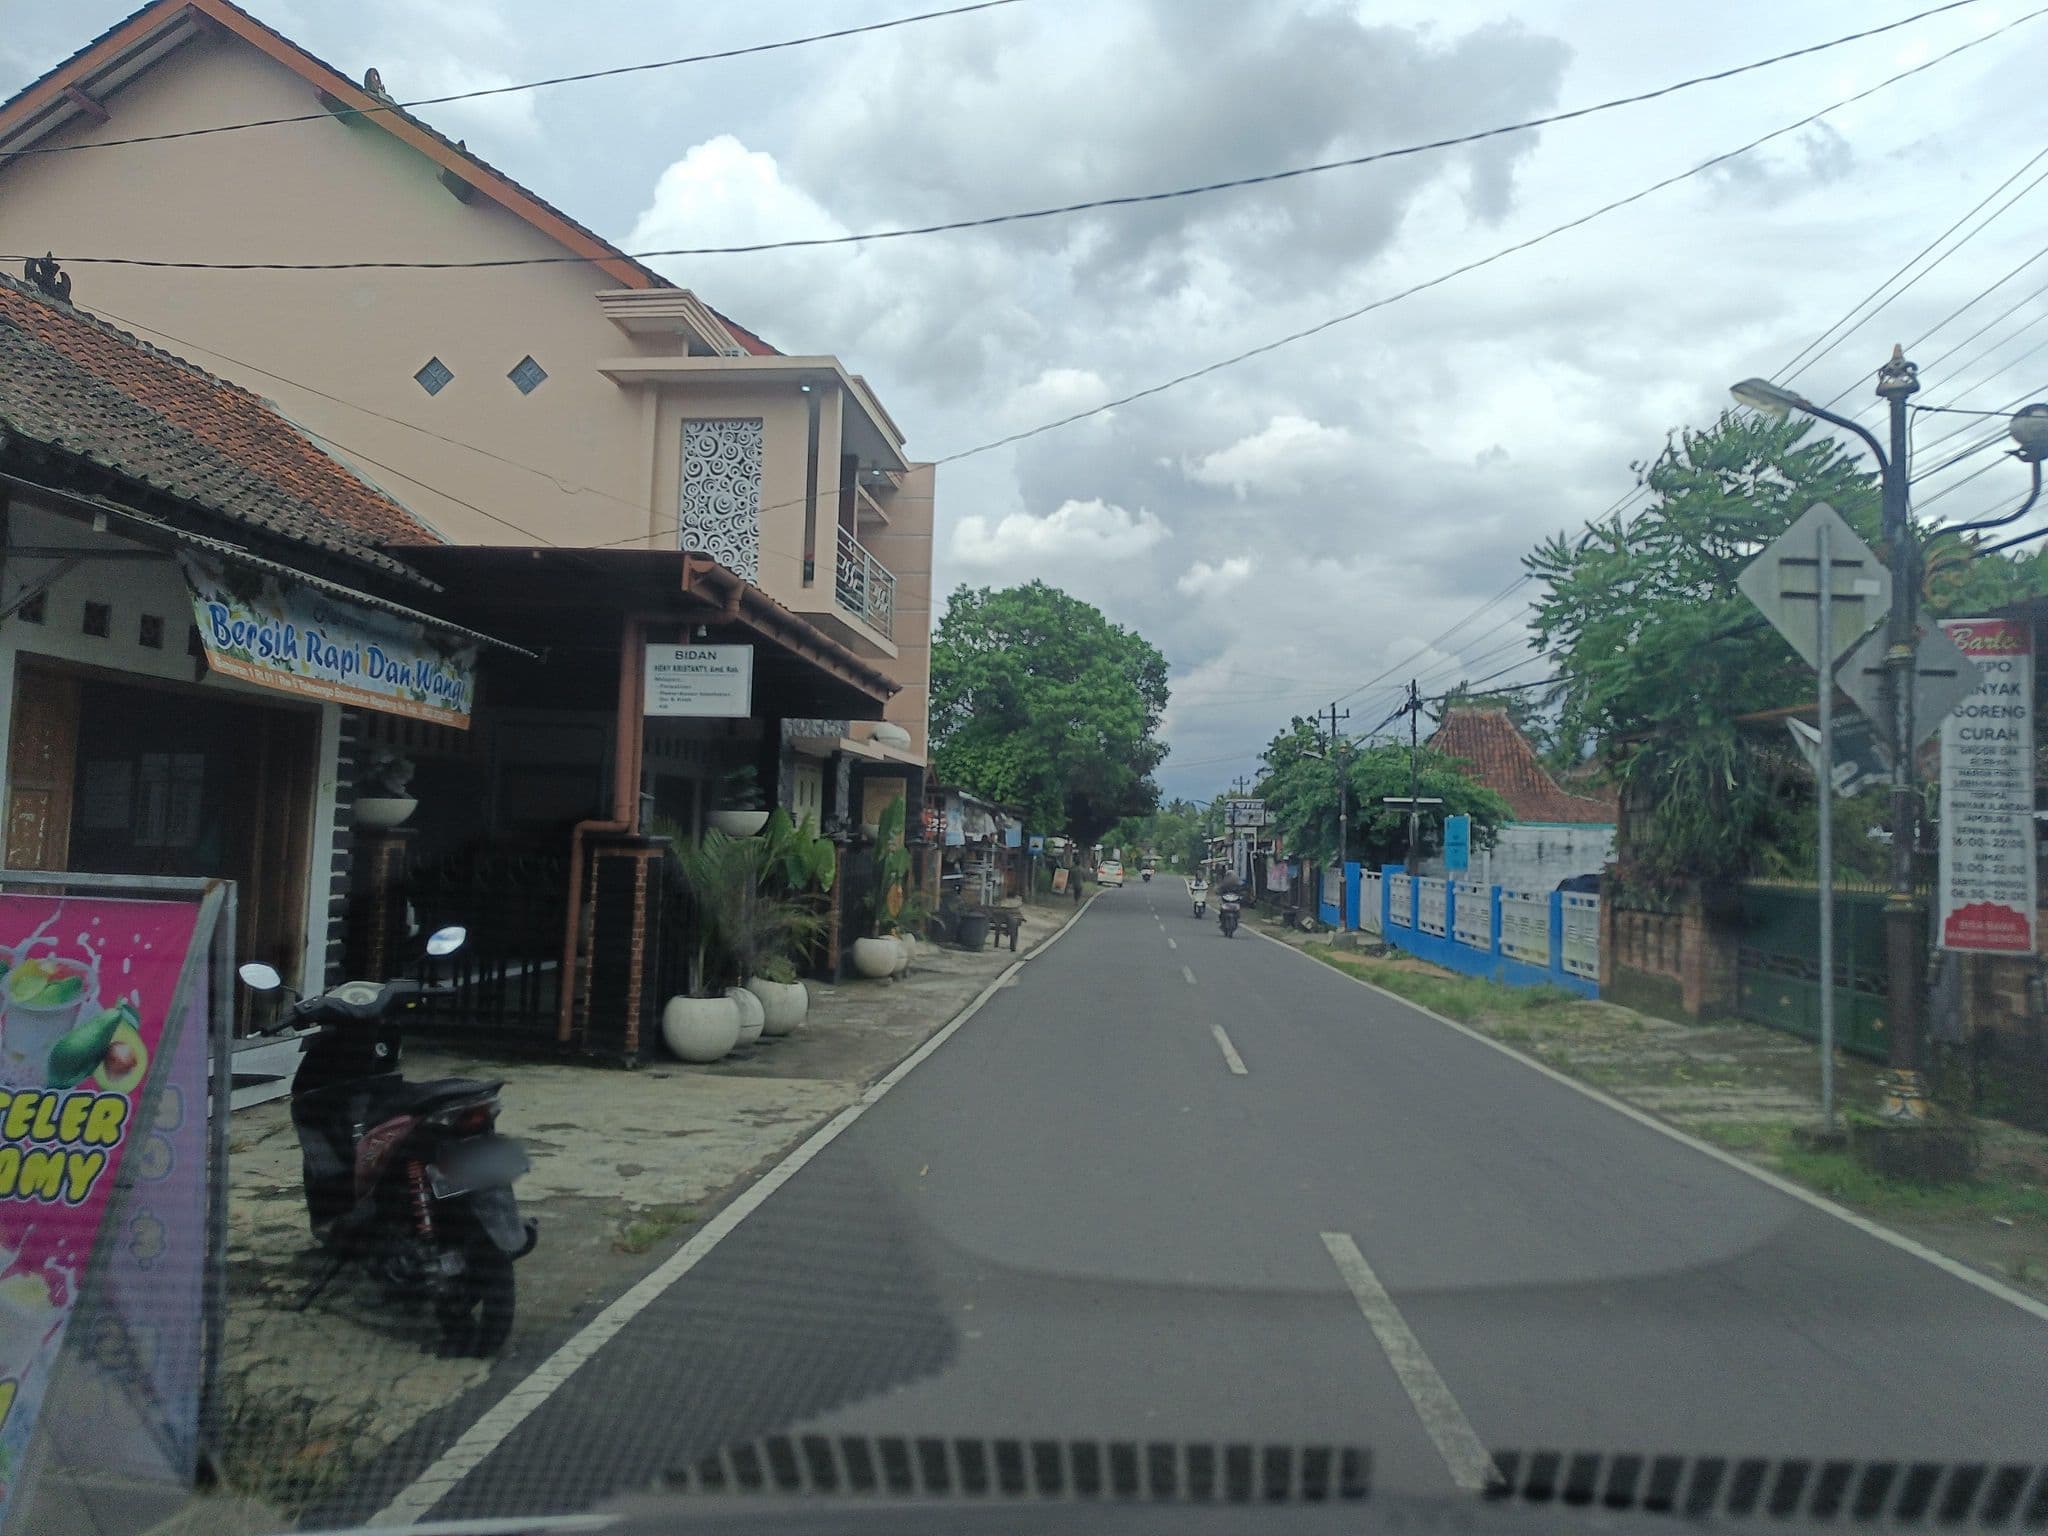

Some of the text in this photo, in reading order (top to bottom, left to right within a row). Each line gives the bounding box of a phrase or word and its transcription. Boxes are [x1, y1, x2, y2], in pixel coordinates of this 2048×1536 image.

[208, 603, 298, 660] Bersih
[305, 629, 361, 680] Rapi
[368, 645, 414, 685] Dan
[416, 659, 466, 710] Wangi
[674, 650, 718, 660] BIDAN
[1975, 661, 2012, 673] EPO
[1970, 683, 2021, 696] NYAK
[1952, 705, 2026, 720] GORENG
[1960, 728, 2019, 741] CURAH
